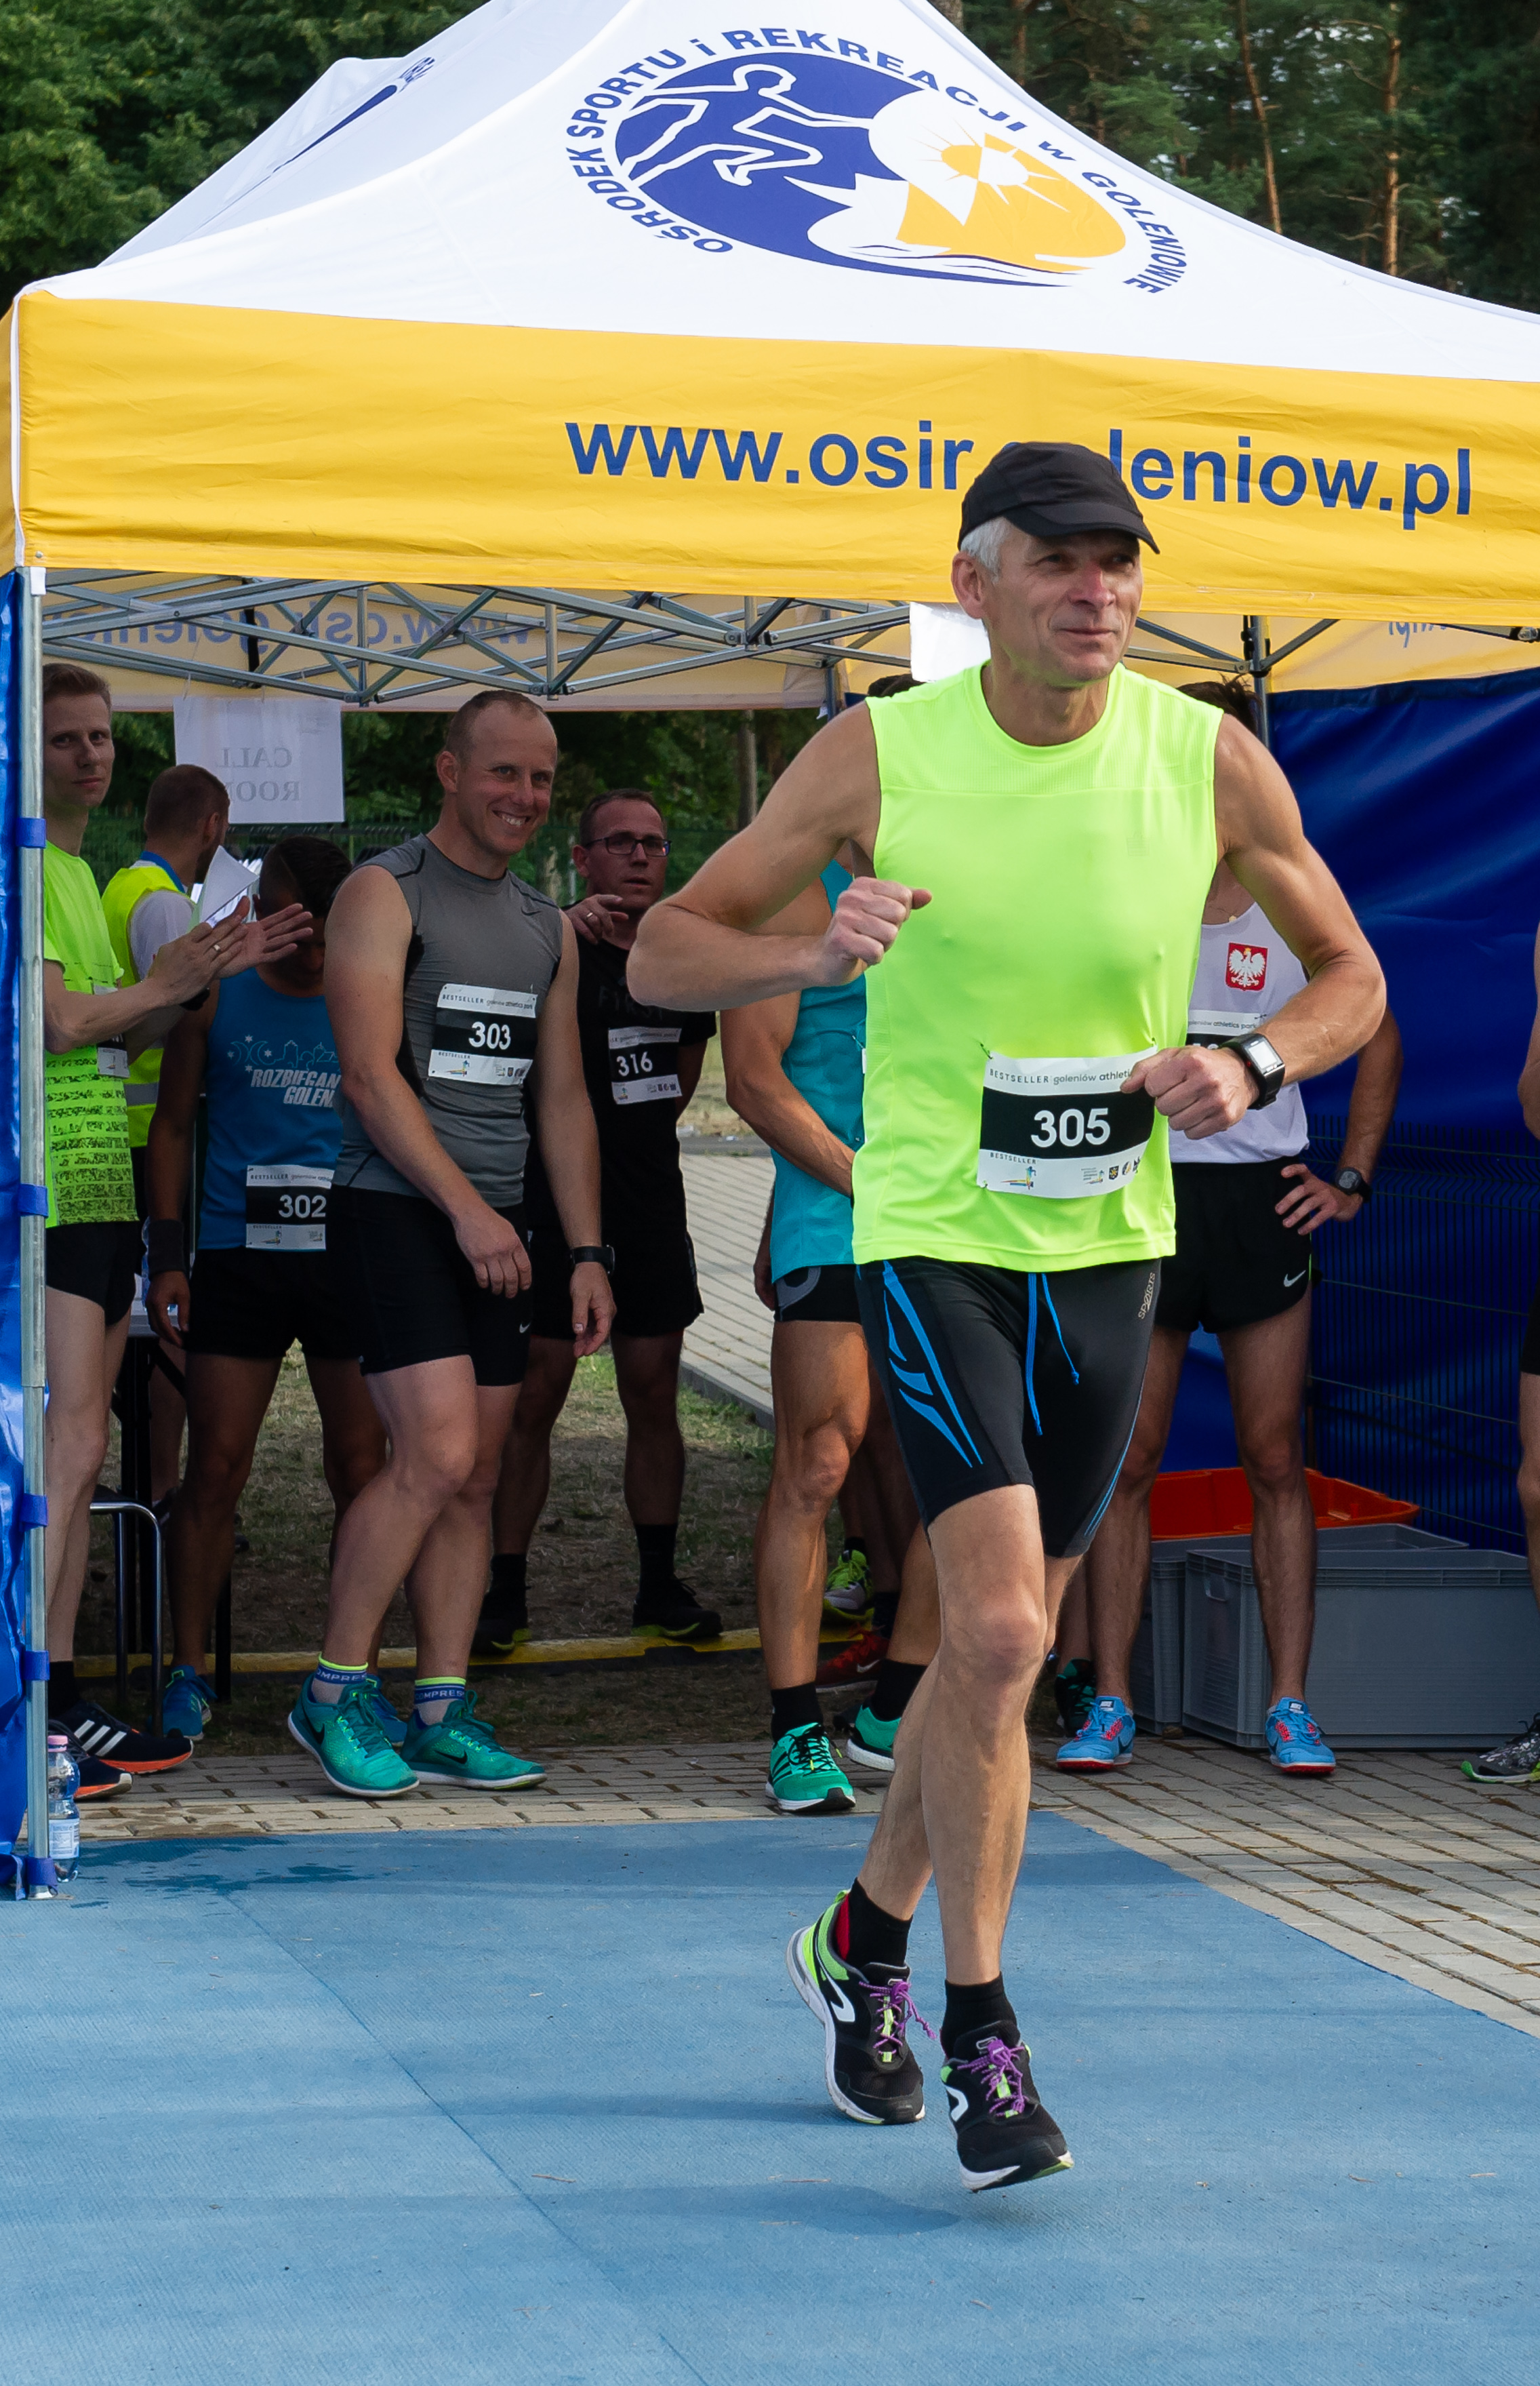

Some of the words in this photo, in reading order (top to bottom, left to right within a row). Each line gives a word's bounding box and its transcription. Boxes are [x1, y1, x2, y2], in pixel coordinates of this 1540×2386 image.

[721, 28, 1028, 132] REKREACJI
[566, 49, 687, 139] SPORTU
[565, 147, 733, 253] OŚRODEK
[1082, 172, 1188, 294] GOLENIOWIE
[565, 420, 1471, 530] www.osirleniow.pl
[443, 994, 484, 1004] BESTSELLER
[468, 1021, 511, 1050] 303
[616, 1052, 653, 1077] 316
[990, 1069, 1049, 1083] BESTSELLER
[1053, 1073, 1096, 1086] goleniów
[1099, 1069, 1131, 1081] athleti
[251, 1069, 341, 1089] ROZBIEGAN
[283, 1086, 335, 1108] GOLEN
[1030, 1107, 1111, 1148] 305
[990, 1152, 1036, 1165] BESTSELLER
[279, 1195, 327, 1218] 302
